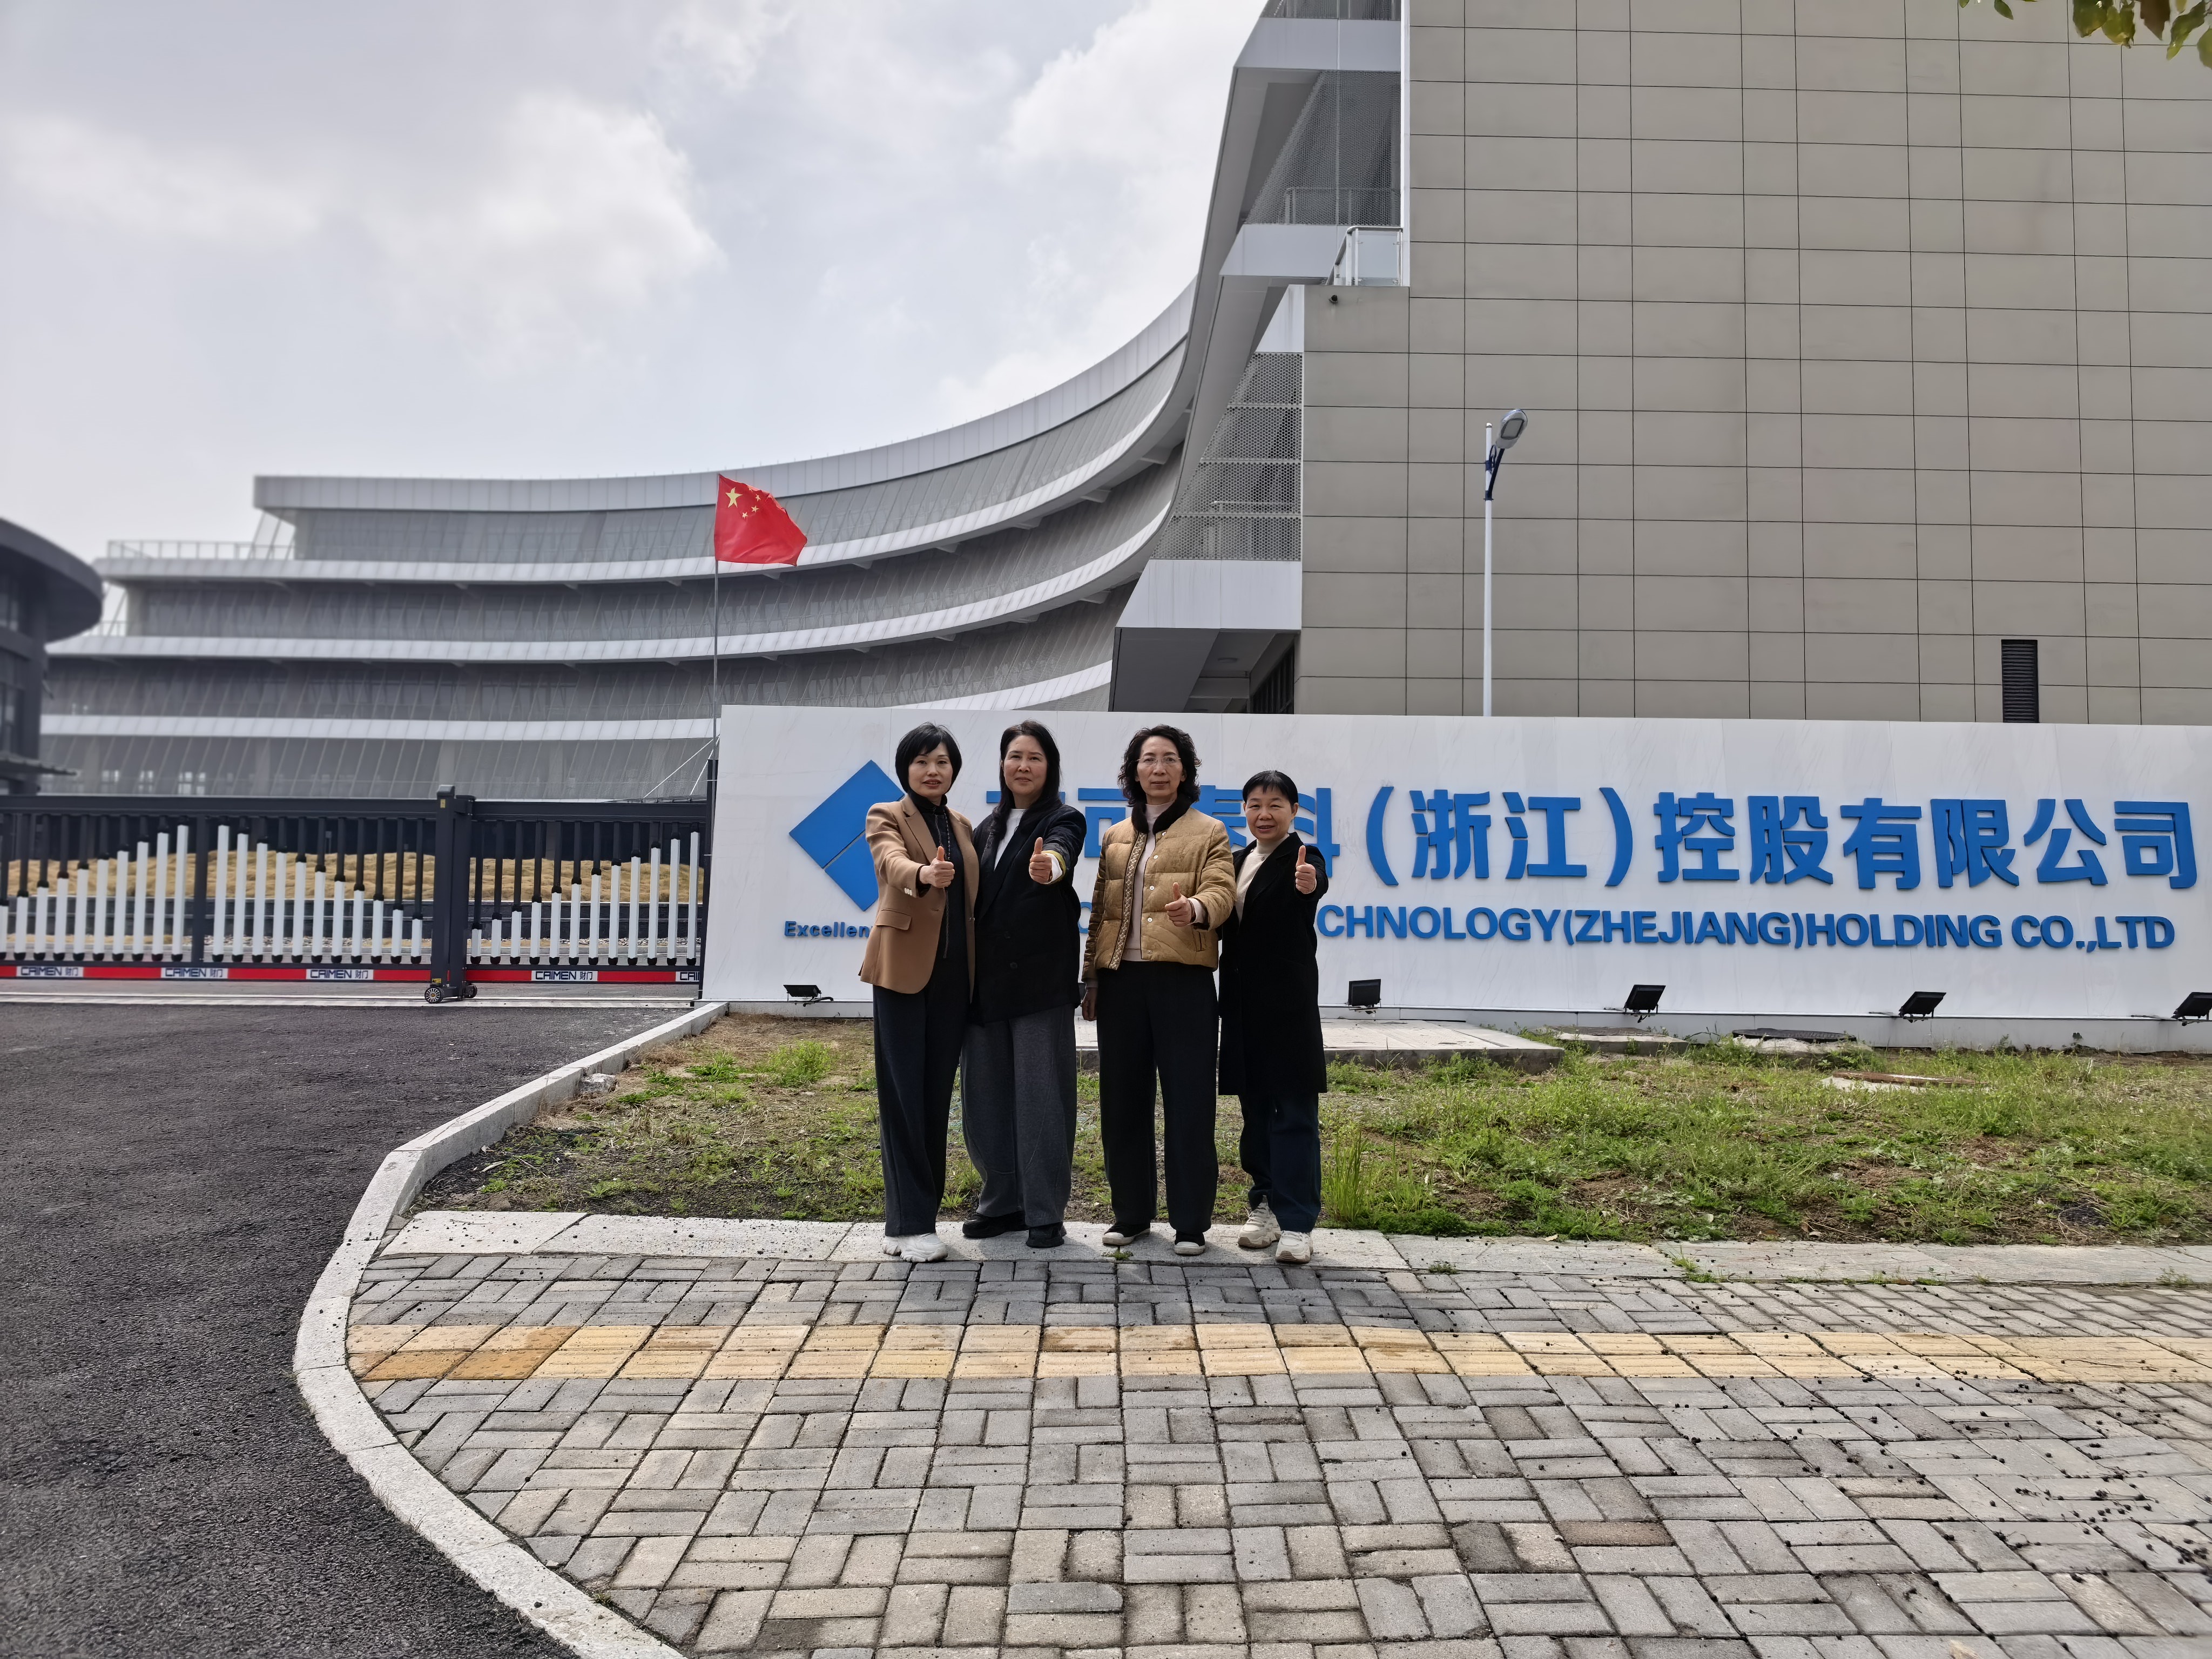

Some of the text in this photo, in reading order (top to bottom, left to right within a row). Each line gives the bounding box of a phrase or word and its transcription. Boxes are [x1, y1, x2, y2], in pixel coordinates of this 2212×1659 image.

[987, 785, 2197, 890] 科（浙江）控股有限公司
[785, 921, 872, 938] Excellen
[1317, 905, 2175, 953] CHNOLOGY(ZHEJIANG)HOLDING CO.,LTD
[165, 968, 206, 977] CAIMEN
[311, 969, 352, 979] CAIMEN
[535, 971, 576, 980] CAIMEN
